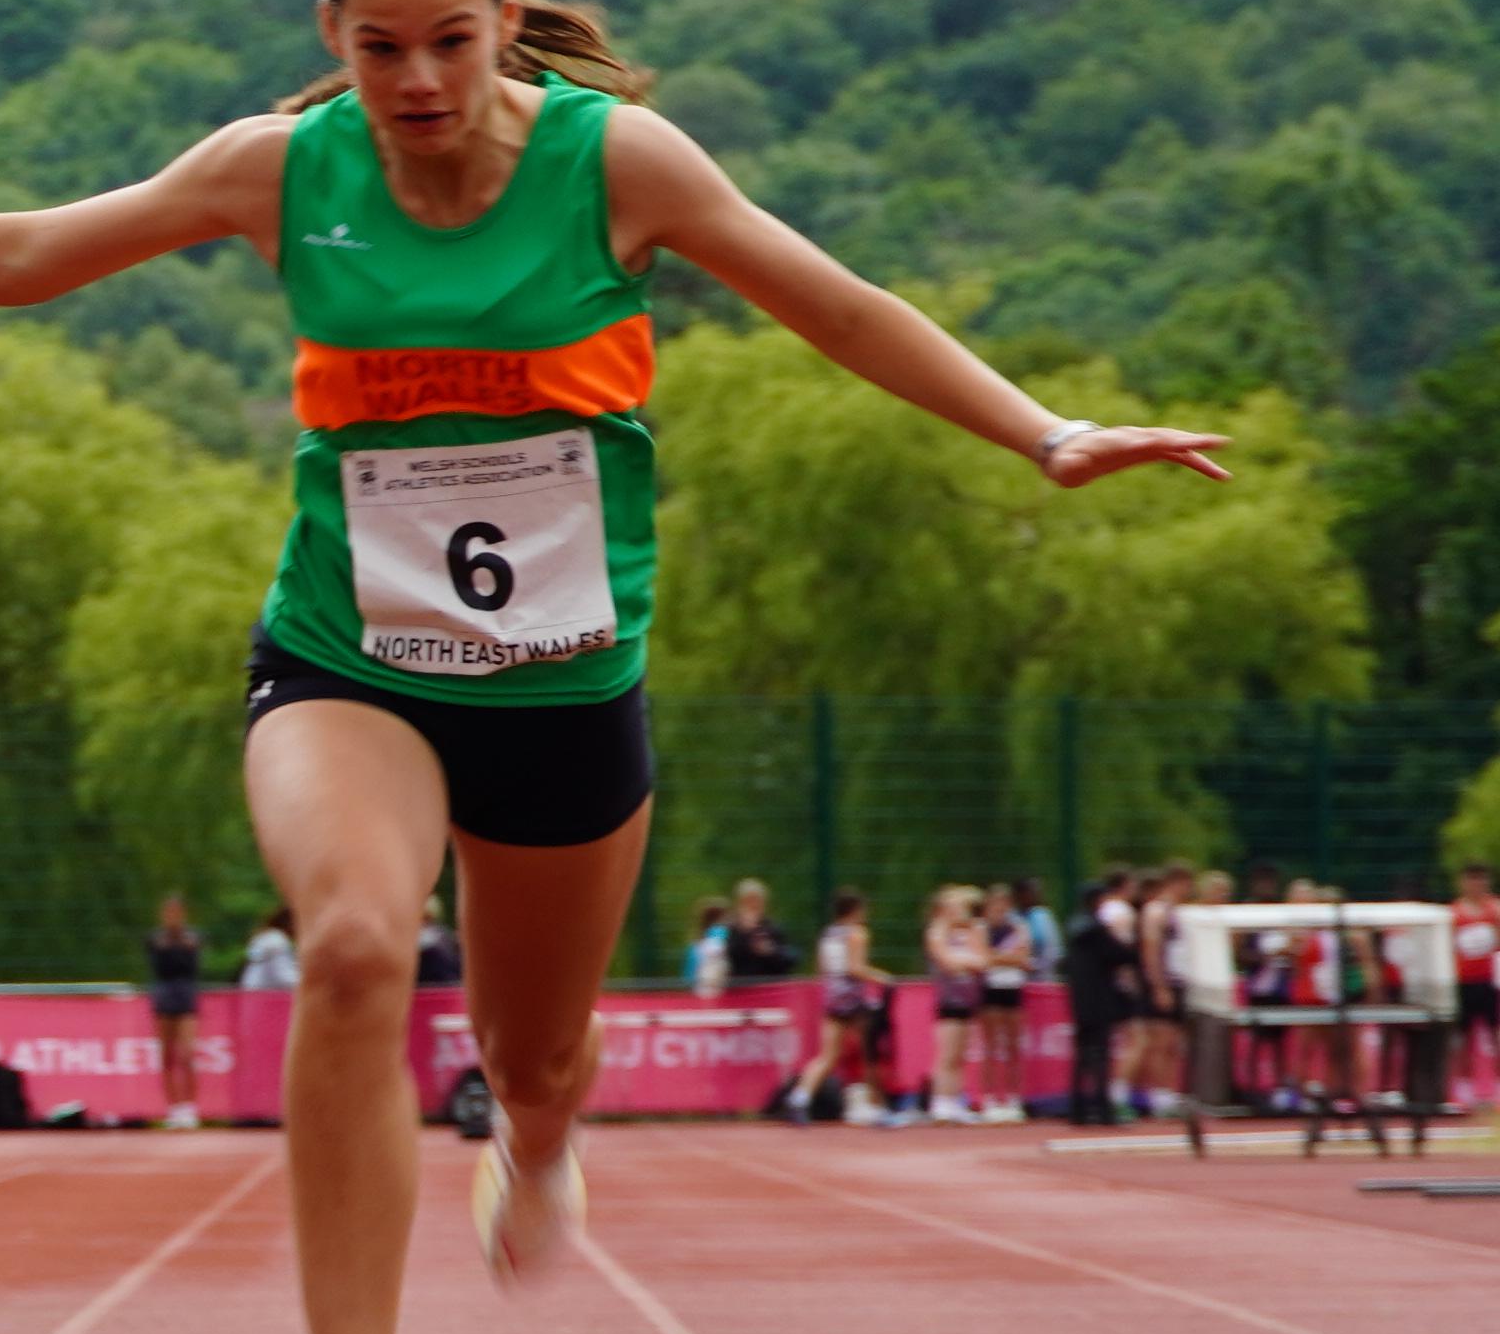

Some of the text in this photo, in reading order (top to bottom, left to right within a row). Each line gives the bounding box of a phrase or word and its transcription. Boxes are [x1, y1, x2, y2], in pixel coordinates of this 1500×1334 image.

[357, 354, 529, 386] NORTH
[362, 380, 533, 417] WALES
[446, 520, 515, 613] 6
[372, 629, 608, 666] NORTH EAST WALES
